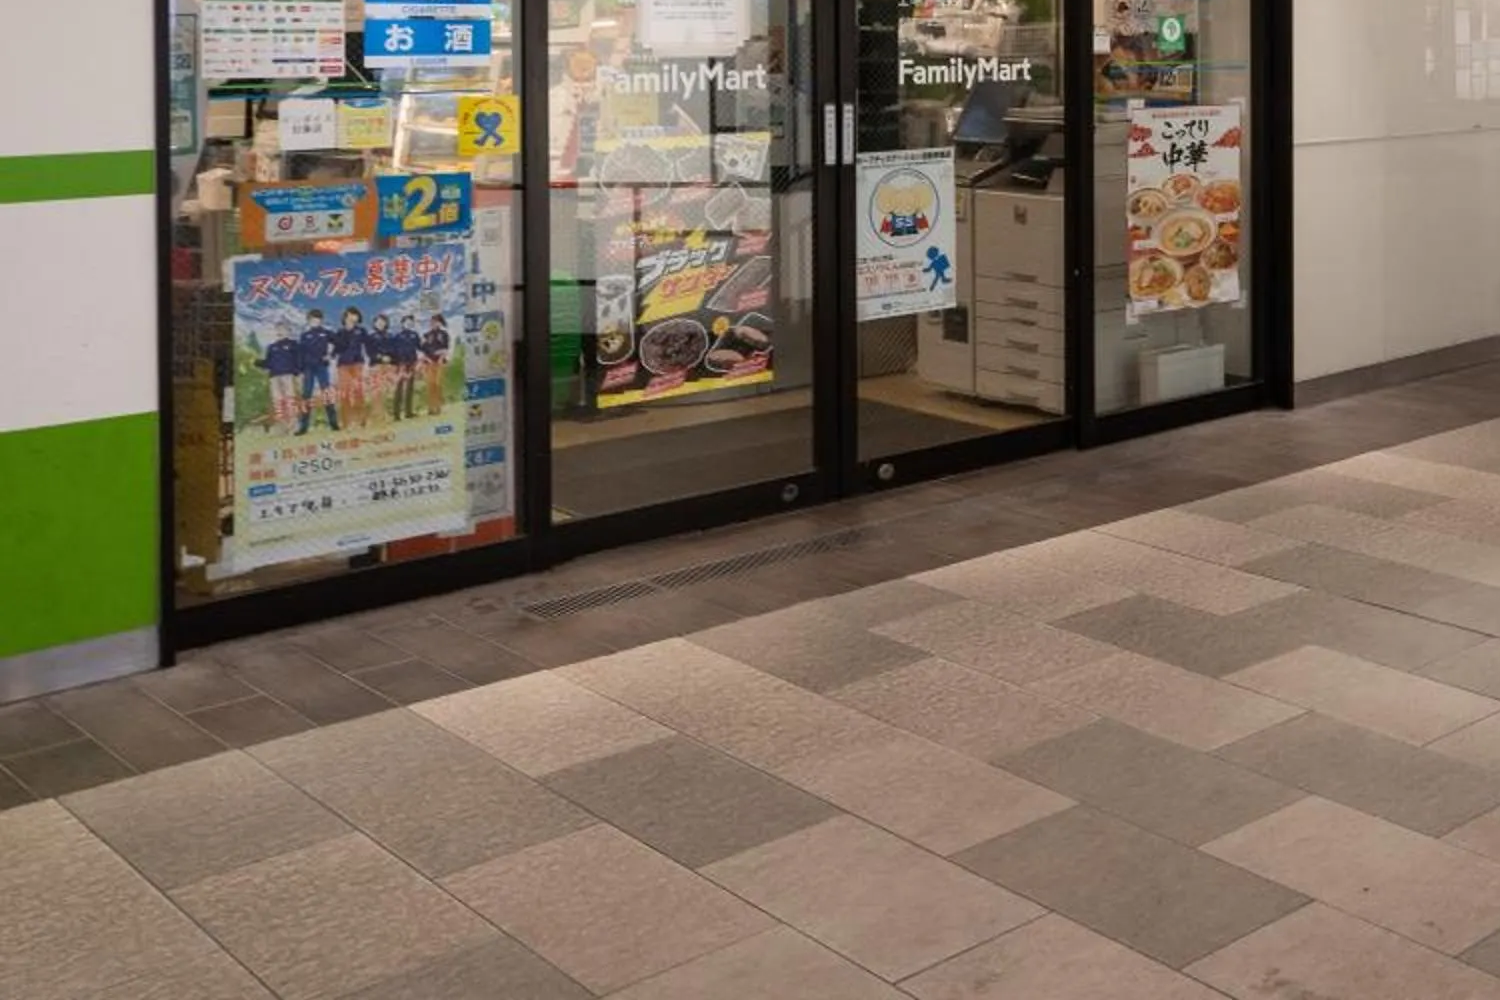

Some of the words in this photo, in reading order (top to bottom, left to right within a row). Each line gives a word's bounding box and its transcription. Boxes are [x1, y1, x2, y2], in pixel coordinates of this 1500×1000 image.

[597, 63, 767, 99] FamilyMart
[899, 58, 1031, 89] FamilyMart
[1161, 119, 1209, 139] こってり
[1163, 139, 1209, 173] 中華
